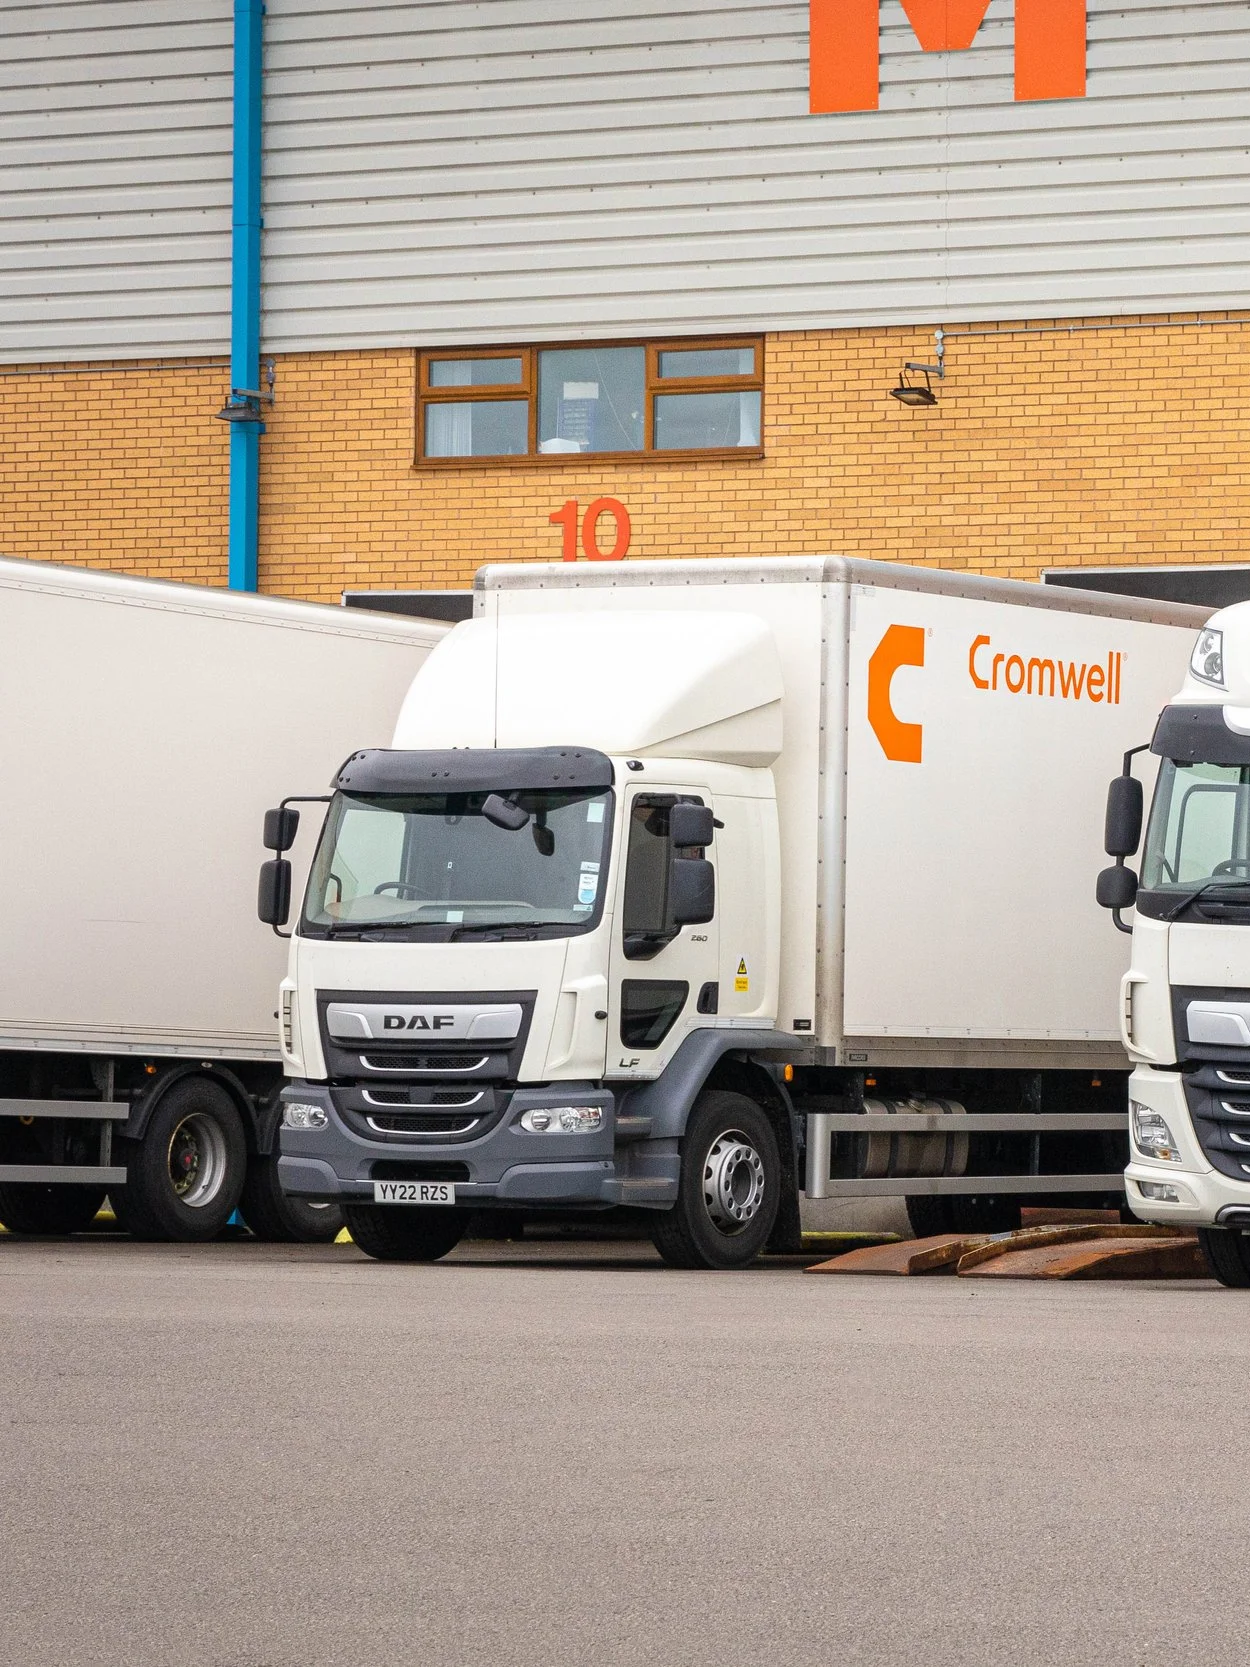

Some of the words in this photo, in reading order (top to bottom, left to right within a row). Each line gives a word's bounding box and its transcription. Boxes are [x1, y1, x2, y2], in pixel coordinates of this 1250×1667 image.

[548, 496, 632, 562] 10
[968, 634, 1121, 704] Cromwell
[383, 1015, 455, 1030] DAF
[619, 1058, 641, 1068] LF
[380, 1184, 417, 1200] YY22
[420, 1185, 449, 1201] RZS
